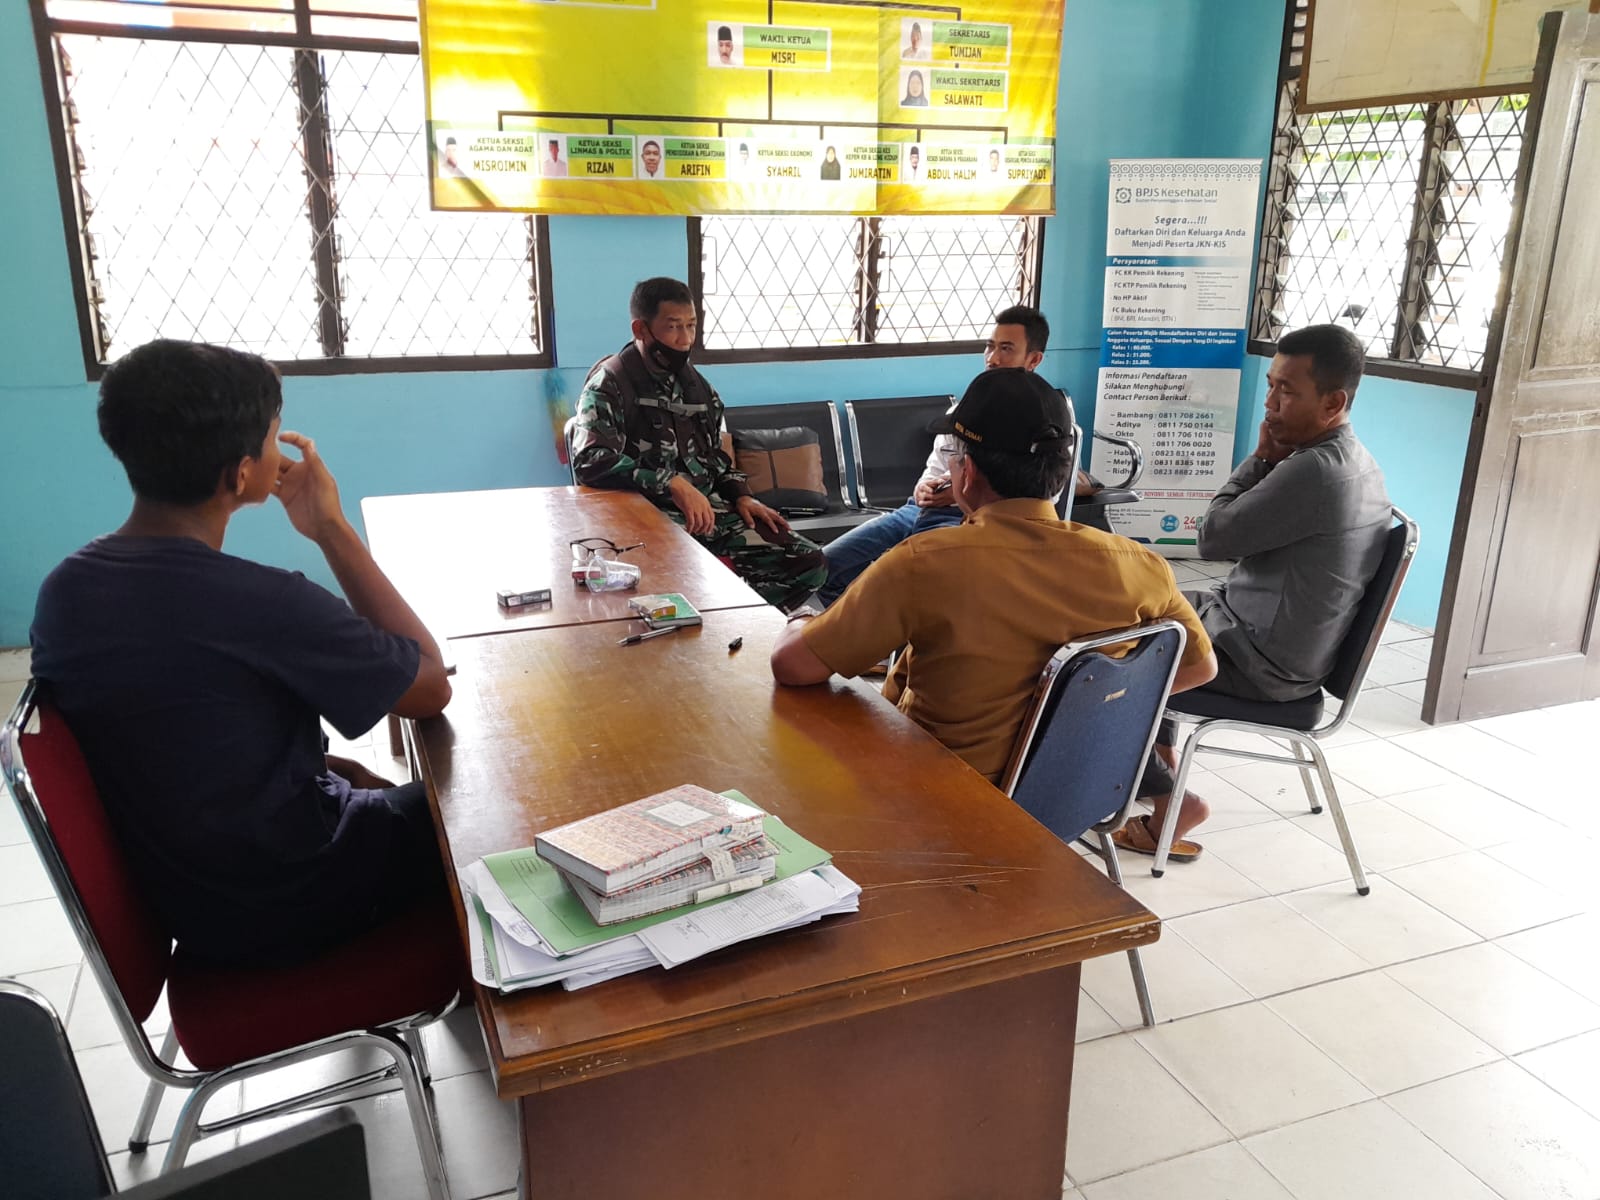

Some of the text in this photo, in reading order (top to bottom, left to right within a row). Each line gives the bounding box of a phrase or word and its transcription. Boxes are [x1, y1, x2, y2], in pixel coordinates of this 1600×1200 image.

[760, 33, 811, 45] WAKIL KETUA
[949, 29, 991, 39] SEKRETARIS
[771, 51, 796, 64] MISRI
[949, 46, 982, 59] TUMIJAN
[936, 77, 1001, 87] WAKIL SEKRETARIS
[944, 94, 983, 106] SALAWATI
[473, 160, 527, 172] MISROIMIN
[587, 162, 614, 174] RIZAN
[681, 163, 711, 176] ARIFIN
[767, 166, 801, 178] SYAHRIL
[849, 168, 892, 179] JUMIRATIN
[927, 169, 977, 180] ABDUL HALIM
[1008, 169, 1046, 180] SUPRIYADI
[1135, 188, 1218, 197] BPJS Kesehatan
[1154, 216, 1208, 226] Segera...!!!
[1114, 228, 1153, 236] Daftarkan
[1155, 228, 1170, 236] Diri
[1171, 228, 1186, 236] dan
[1187, 229, 1223, 238] Keluarga
[1131, 240, 1163, 248] Menjadi
[1112, 258, 1159, 266] Persyaratan:
[1105, 371, 1187, 380] Informasi Pendaftaran
[1133, 383, 1185, 392] Menghubungi
[1133, 393, 1159, 401] Person
[1117, 412, 1153, 420] Bambang
[1116, 421, 1141, 429] Aditya
